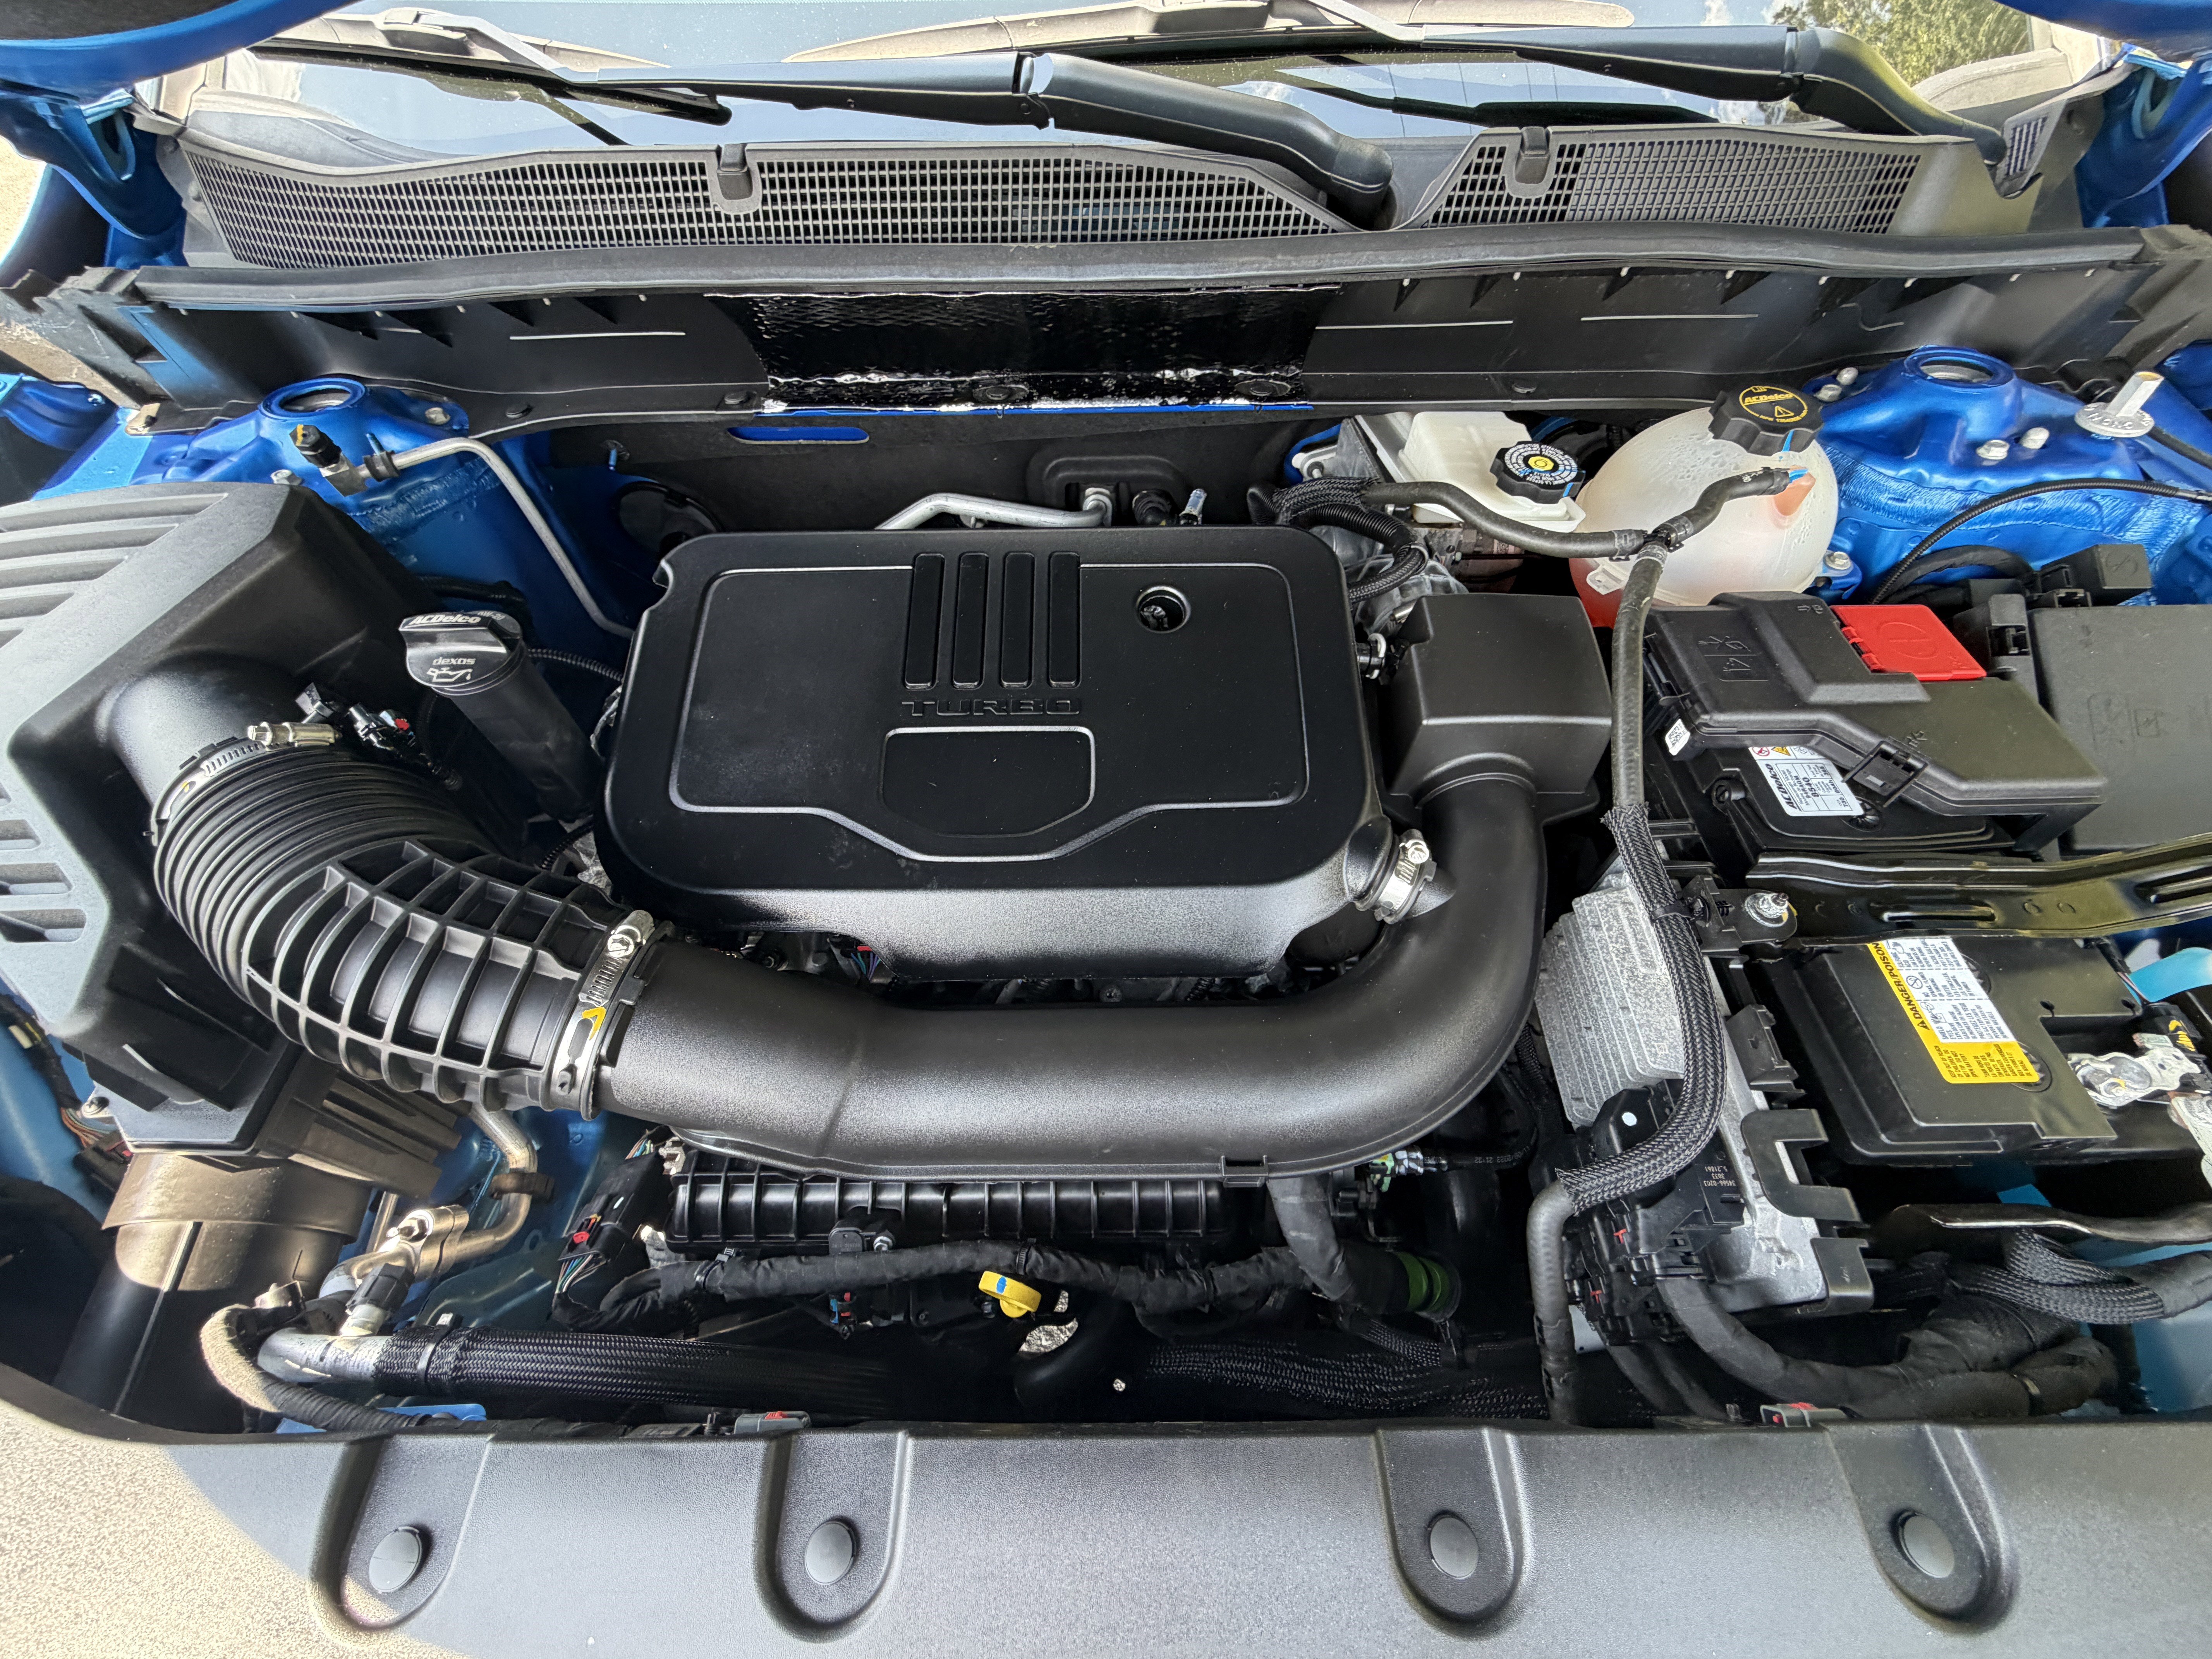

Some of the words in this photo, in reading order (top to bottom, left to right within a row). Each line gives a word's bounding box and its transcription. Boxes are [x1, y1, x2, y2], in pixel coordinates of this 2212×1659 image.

[1744, 394, 1793, 403] ACDelco
[409, 615, 481, 625] ACDelco
[432, 657, 476, 665] dexos
[902, 698, 1081, 716] TURBO
[1765, 764, 1796, 809] ACDelco
[1802, 777, 1819, 797] 8540
[1839, 797, 1848, 807] 730
[1872, 943, 1922, 1019] DANGER/POISON
[1936, 1026, 1949, 1039] SHIELD
[1946, 1030, 1956, 1039] EYES
